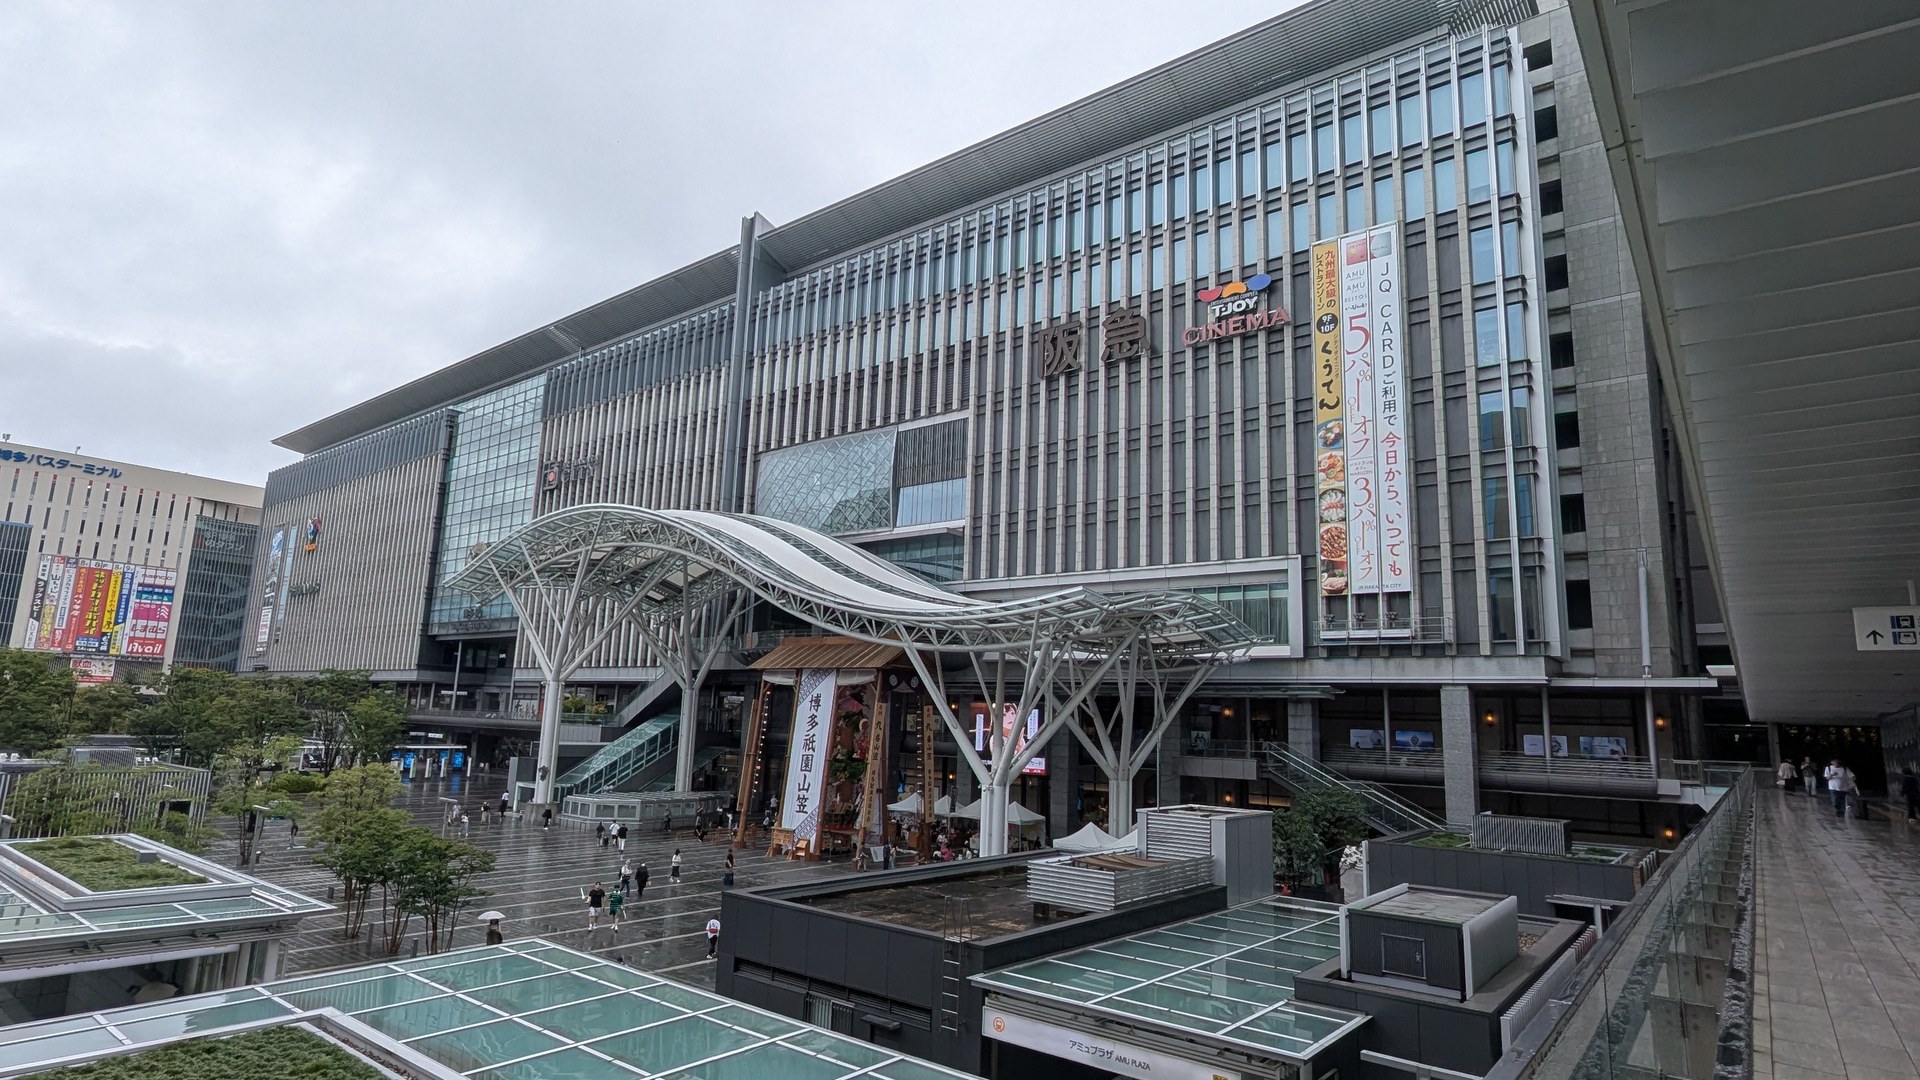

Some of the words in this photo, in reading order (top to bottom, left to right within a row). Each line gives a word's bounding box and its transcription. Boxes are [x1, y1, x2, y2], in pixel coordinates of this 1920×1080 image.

[1315, 253, 1325, 311] レストランゾーン
[1325, 250, 1337, 308] 九州最大級の
[1379, 262, 1392, 293] JQ
[1181, 305, 1292, 347] CINEMA
[1320, 323, 1335, 332] 10F
[1322, 314, 1332, 322] 9F
[1038, 308, 1151, 379] 阪急
[1319, 340, 1340, 410] くうてん
[0, 448, 122, 478] 博多バスターミナル
[33, 581, 45, 617] ラックスビー
[130, 624, 166, 634] しまむら
[128, 642, 162, 653] Avail
[795, 693, 822, 815] 博多祇園山笠
[1069, 1039, 1114, 1060] アミュプラザ
[1115, 1055, 1130, 1066] AMU
[1131, 1058, 1150, 1070] PLAZA
